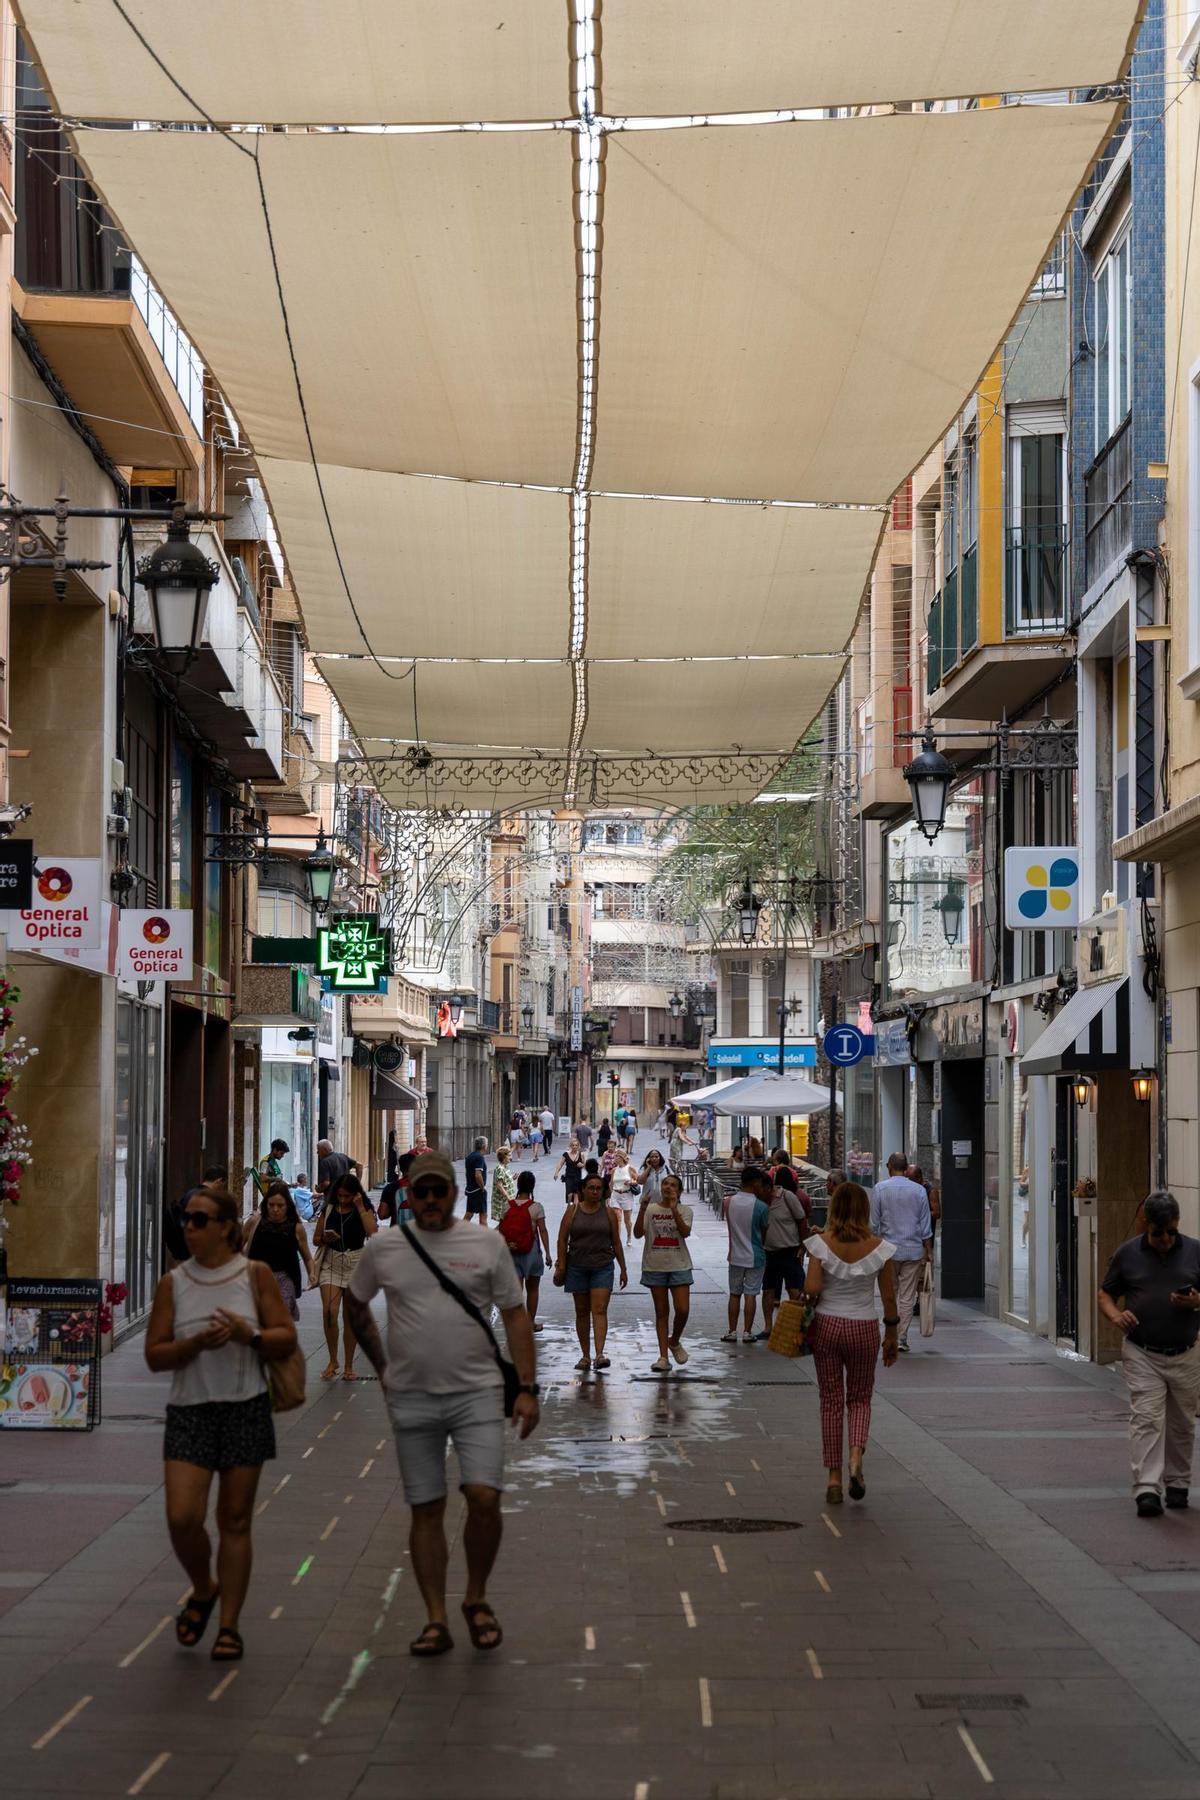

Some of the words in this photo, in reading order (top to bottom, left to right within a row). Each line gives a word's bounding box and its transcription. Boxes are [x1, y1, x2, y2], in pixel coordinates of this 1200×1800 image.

[20, 907, 88, 921] General
[25, 923, 82, 940] Optica
[129, 948, 183, 959] General
[133, 960, 178, 975] Optica
[10, 1284, 99, 1296] levaduramadre
